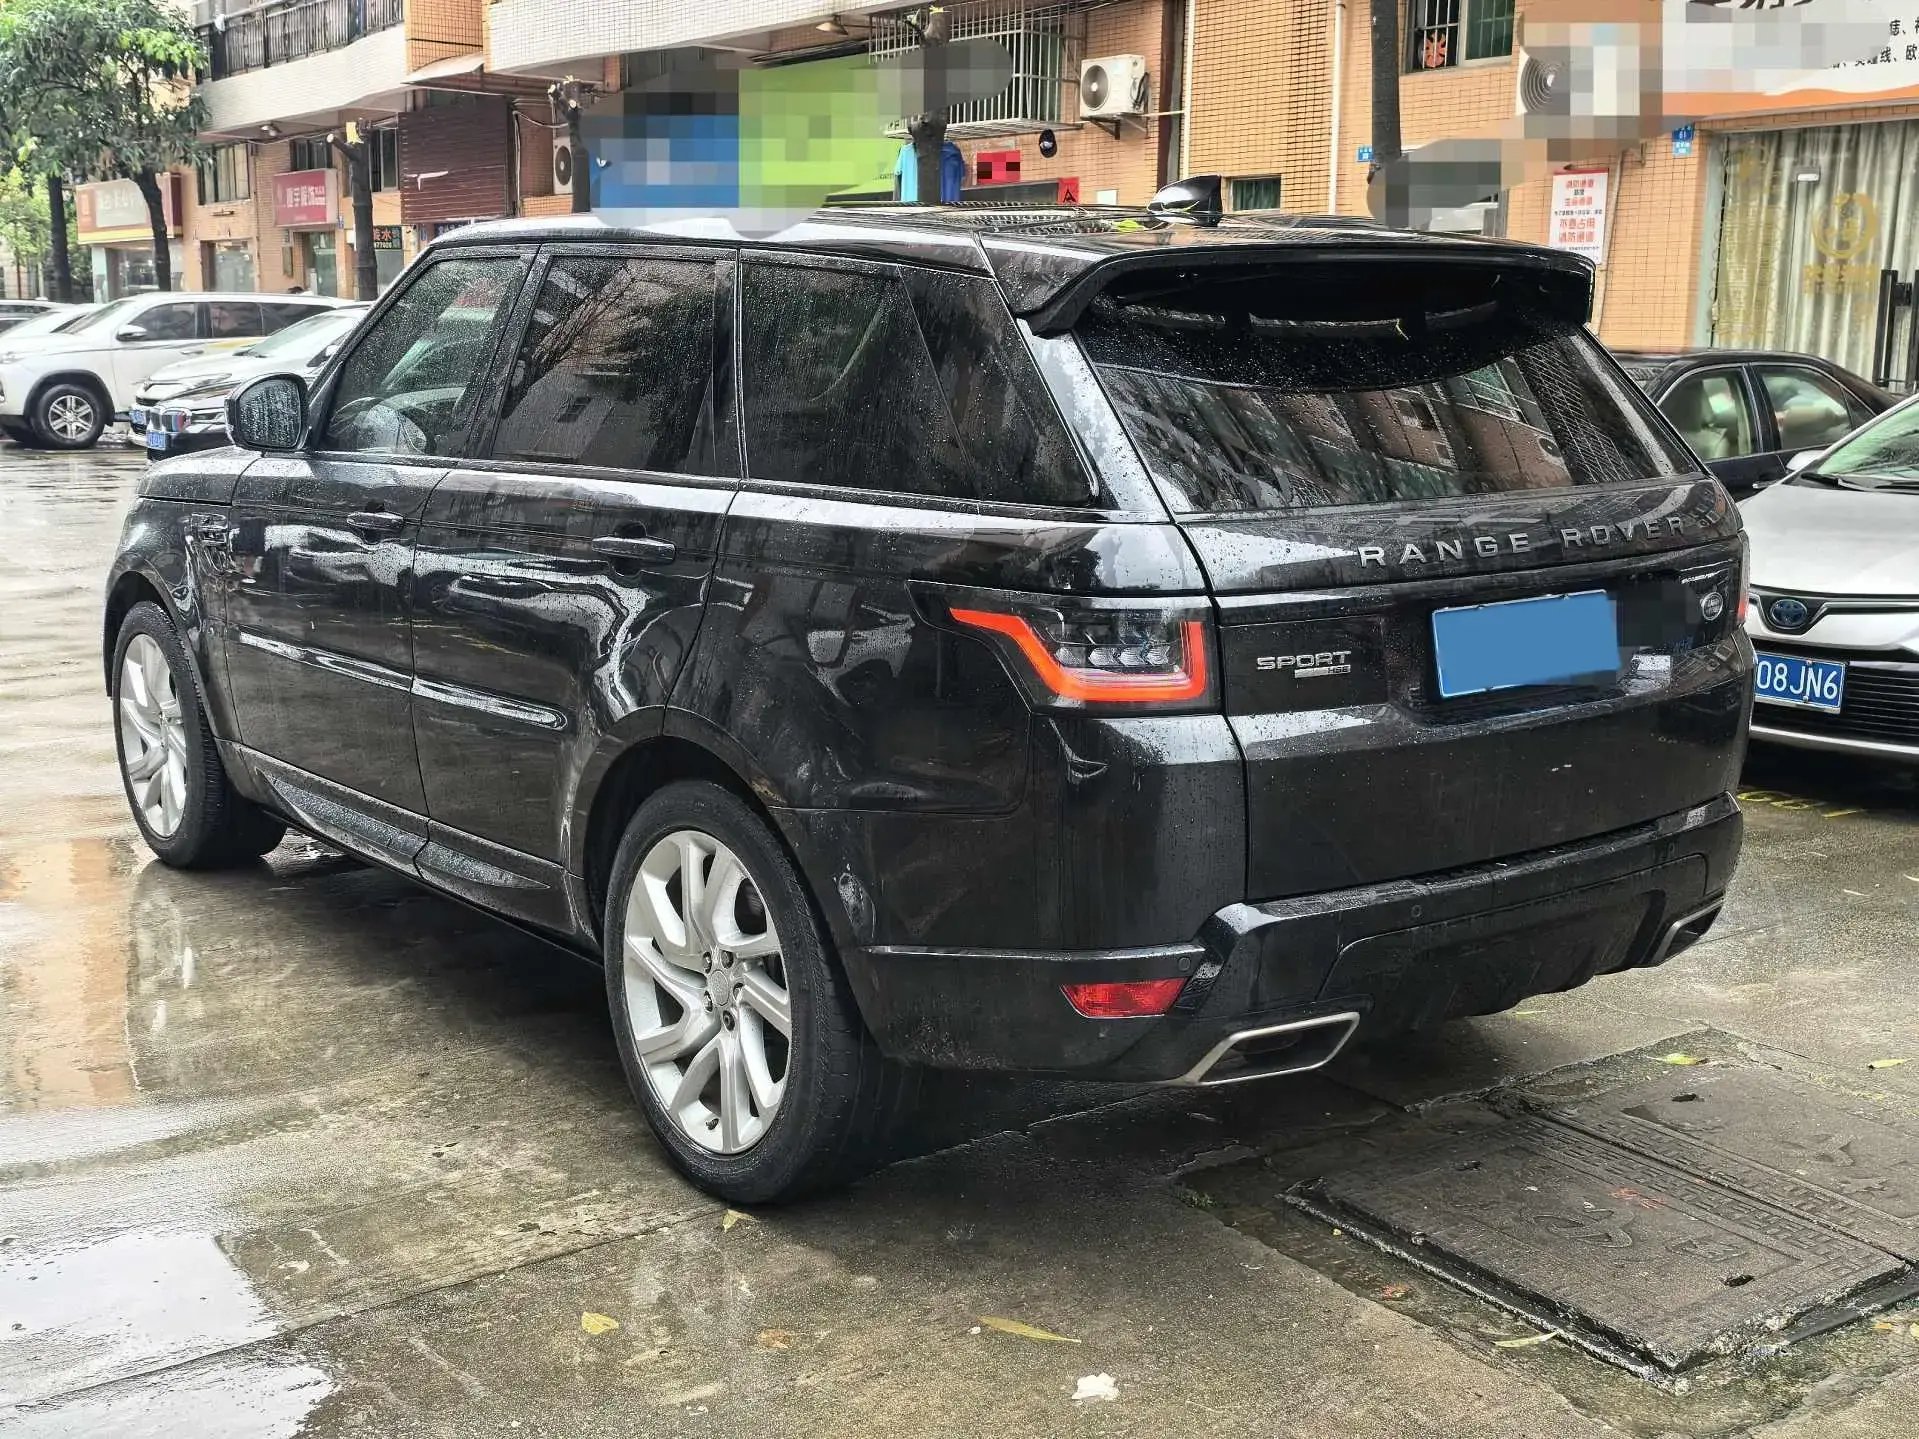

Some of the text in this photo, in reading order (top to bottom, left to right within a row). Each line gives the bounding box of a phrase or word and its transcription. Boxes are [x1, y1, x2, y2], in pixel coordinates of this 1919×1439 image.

[1360, 516, 1686, 568] RANGE ROVER
[1257, 650, 1352, 670] SPORT
